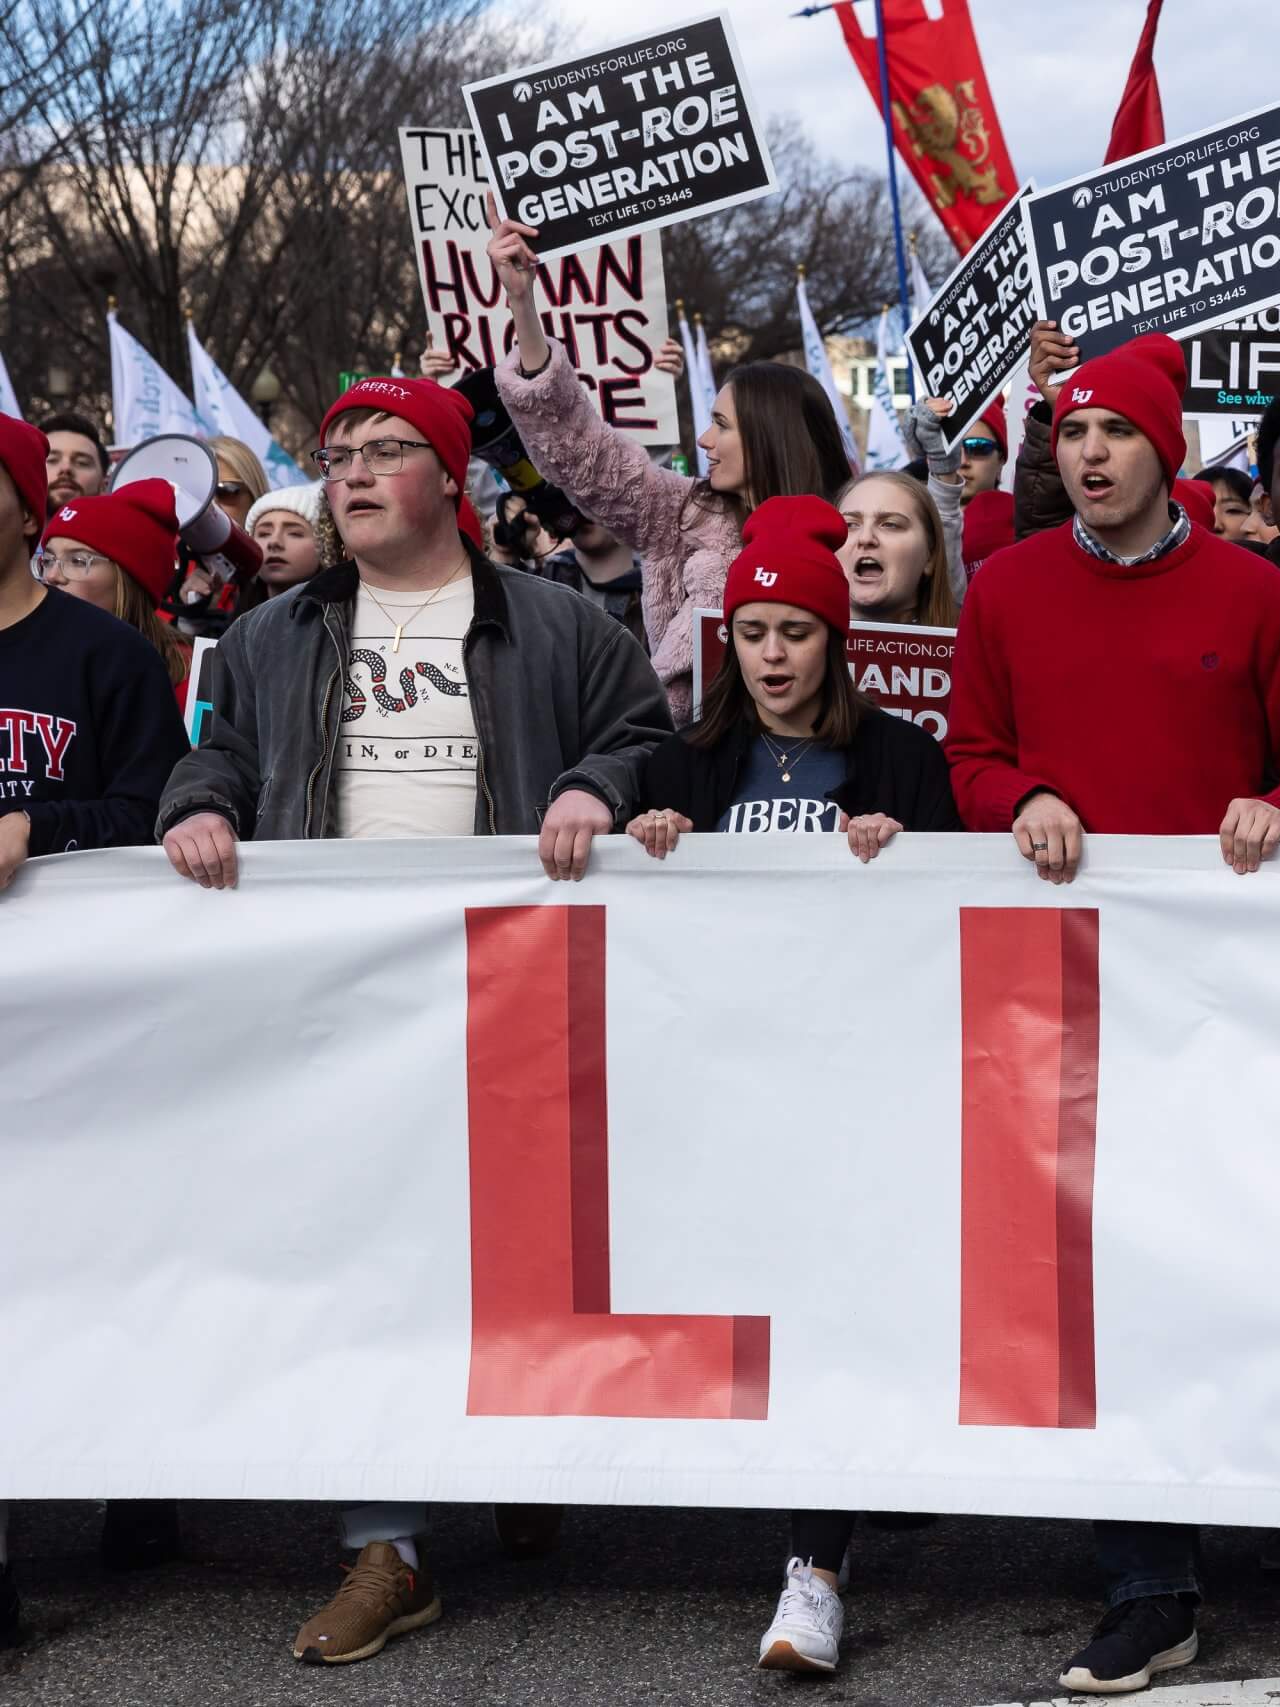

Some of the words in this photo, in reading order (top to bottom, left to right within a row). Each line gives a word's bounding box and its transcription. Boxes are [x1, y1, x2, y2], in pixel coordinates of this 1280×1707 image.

[533, 37, 687, 95] STUDENTSFORLIFE.ORG
[497, 113, 513, 142] I
[536, 86, 605, 132] AM
[622, 52, 715, 101] THE
[497, 84, 740, 190] POST-ROE
[1094, 126, 1261, 198] STUDENTSFORLIFE.ORG
[517, 132, 749, 227] GENERATION
[588, 212, 614, 227] TEXT
[616, 205, 639, 220] LIFE
[640, 200, 655, 212] TO
[657, 188, 693, 208] 53445
[1054, 220, 1066, 252] I
[1091, 184, 1167, 239] AM
[939, 216, 1016, 314] STUDENTSFORLIFE.ORG
[924, 339, 935, 362] I
[943, 284, 979, 343] AM
[1132, 317, 1160, 335] TEXT
[1163, 307, 1188, 325] LIFE
[1190, 301, 1207, 315] TO
[1209, 285, 1247, 309] 53445
[979, 378, 993, 395] TEXT
[993, 363, 1006, 379] LIFE
[1005, 349, 1015, 365] TO
[1071, 387, 1094, 404] LU
[1217, 391, 1242, 404] See
[59, 506, 78, 521] LU
[754, 566, 778, 587] LU
[443, 662, 459, 674] N.E.
[394, 749, 410, 760] or
[423, 744, 477, 759] DIE.
